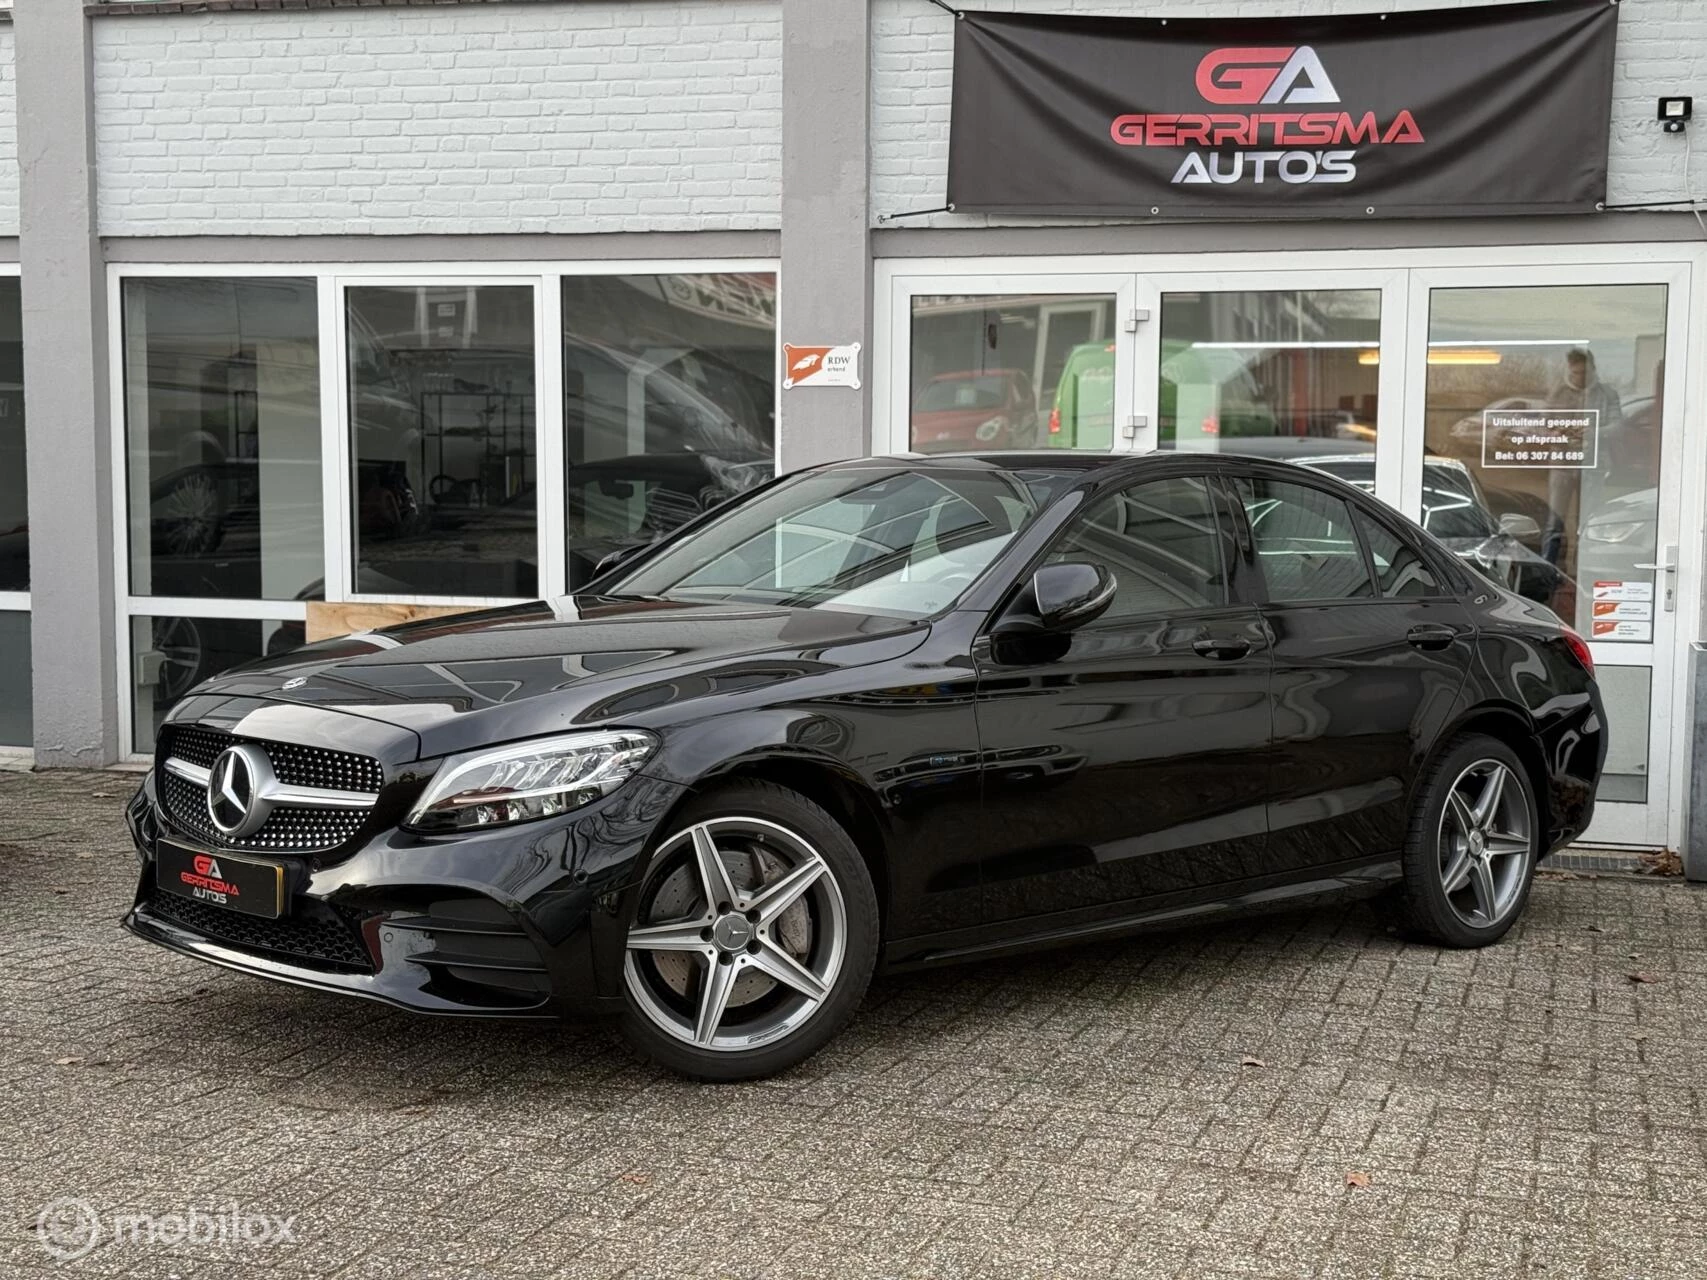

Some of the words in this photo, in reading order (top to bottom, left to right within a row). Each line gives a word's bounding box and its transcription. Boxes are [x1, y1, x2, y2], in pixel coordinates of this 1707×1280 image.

[1195, 45, 1342, 105] GA
[1110, 110, 1425, 146] GERRITSMA
[1170, 150, 1357, 185] AUTO'S
[828, 356, 851, 365] RDW
[1492, 418, 1545, 427] Uitsluitend
[1547, 418, 1589, 428] geopend
[1511, 437, 1524, 445] op
[1526, 435, 1568, 445] afspraak
[1495, 452, 1514, 460] Bel:
[1516, 452, 1529, 460] 06
[1530, 452, 1549, 460] 307
[1550, 452, 1563, 460] 84
[1565, 452, 1585, 460] 689
[194, 855, 222, 879] GA
